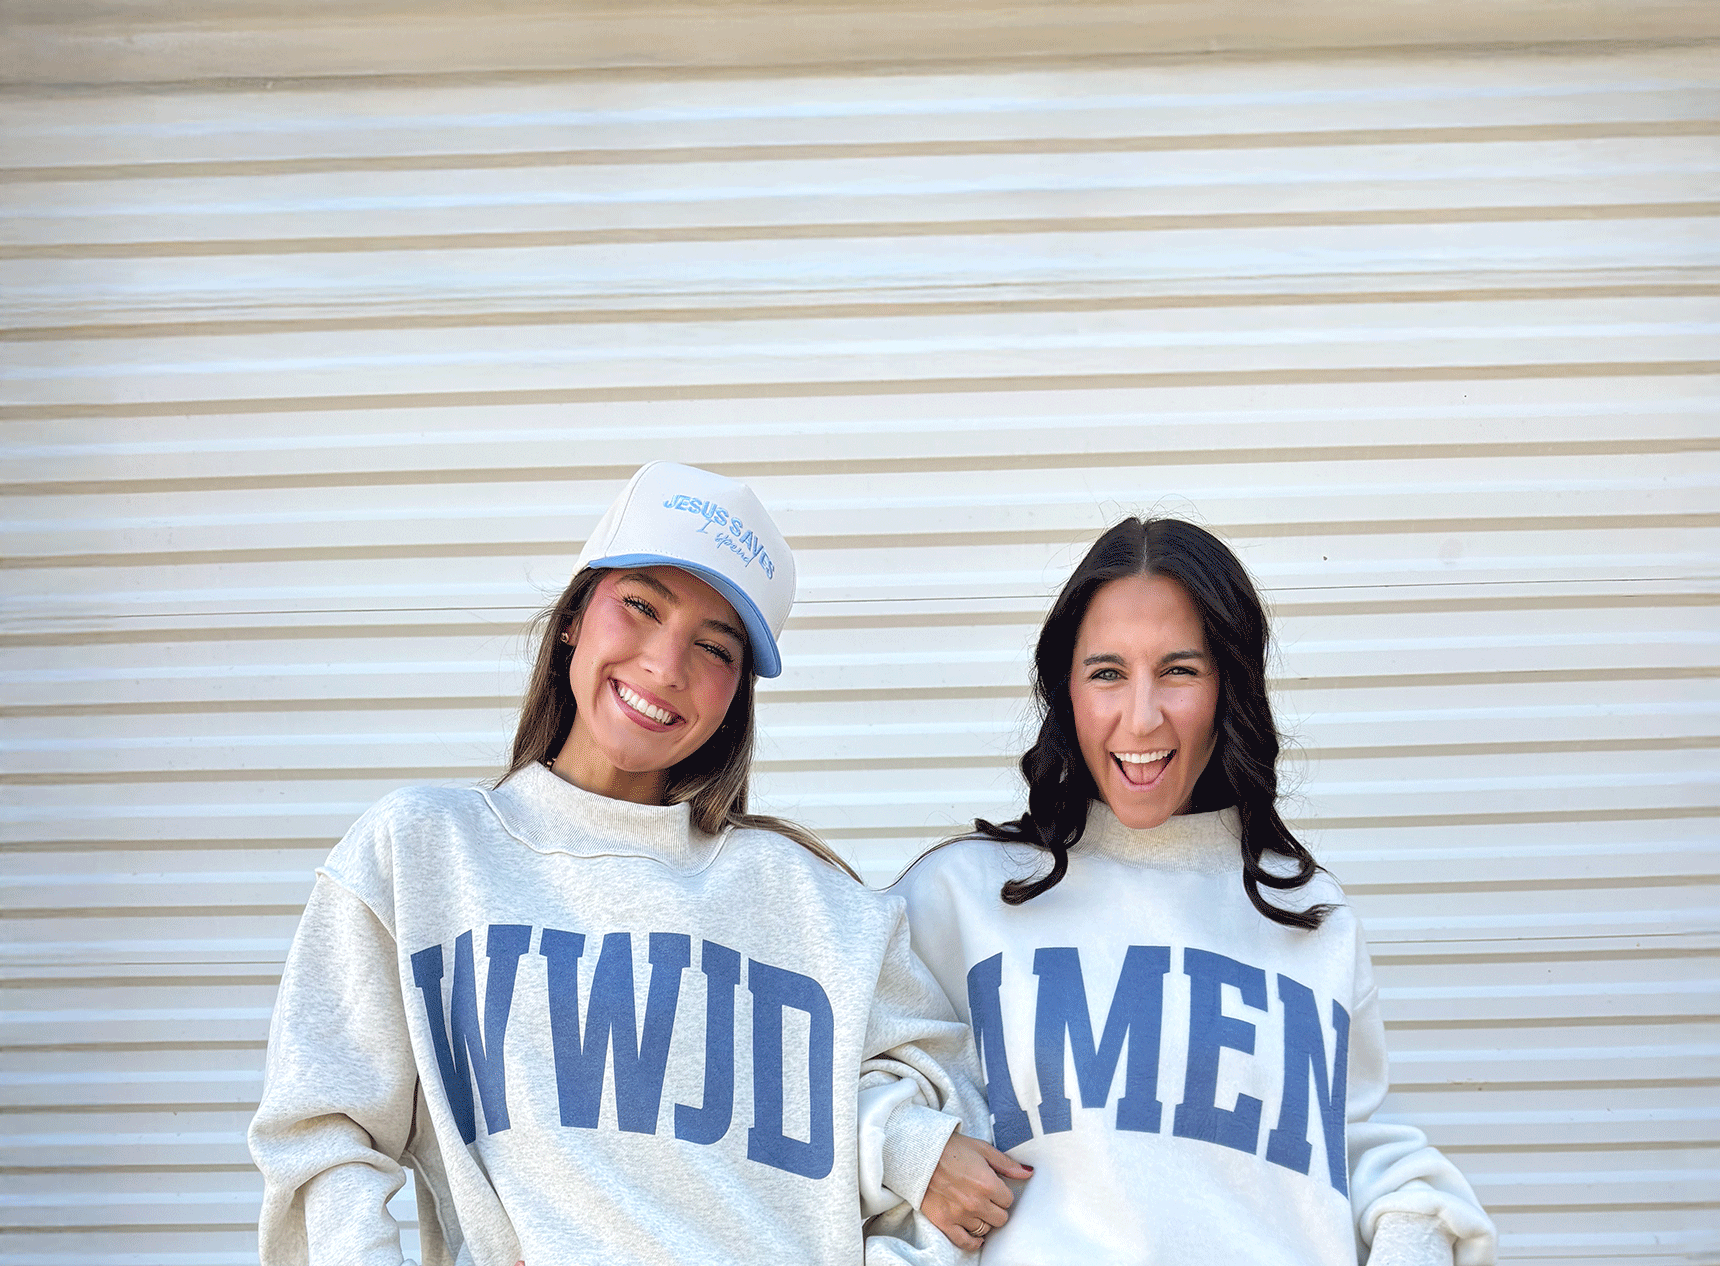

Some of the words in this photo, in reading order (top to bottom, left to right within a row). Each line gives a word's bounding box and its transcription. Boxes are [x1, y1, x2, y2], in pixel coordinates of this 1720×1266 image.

[663, 494, 729, 526] JESUS
[729, 517, 775, 580] SAVES
[410, 924, 835, 1180] WWJD
